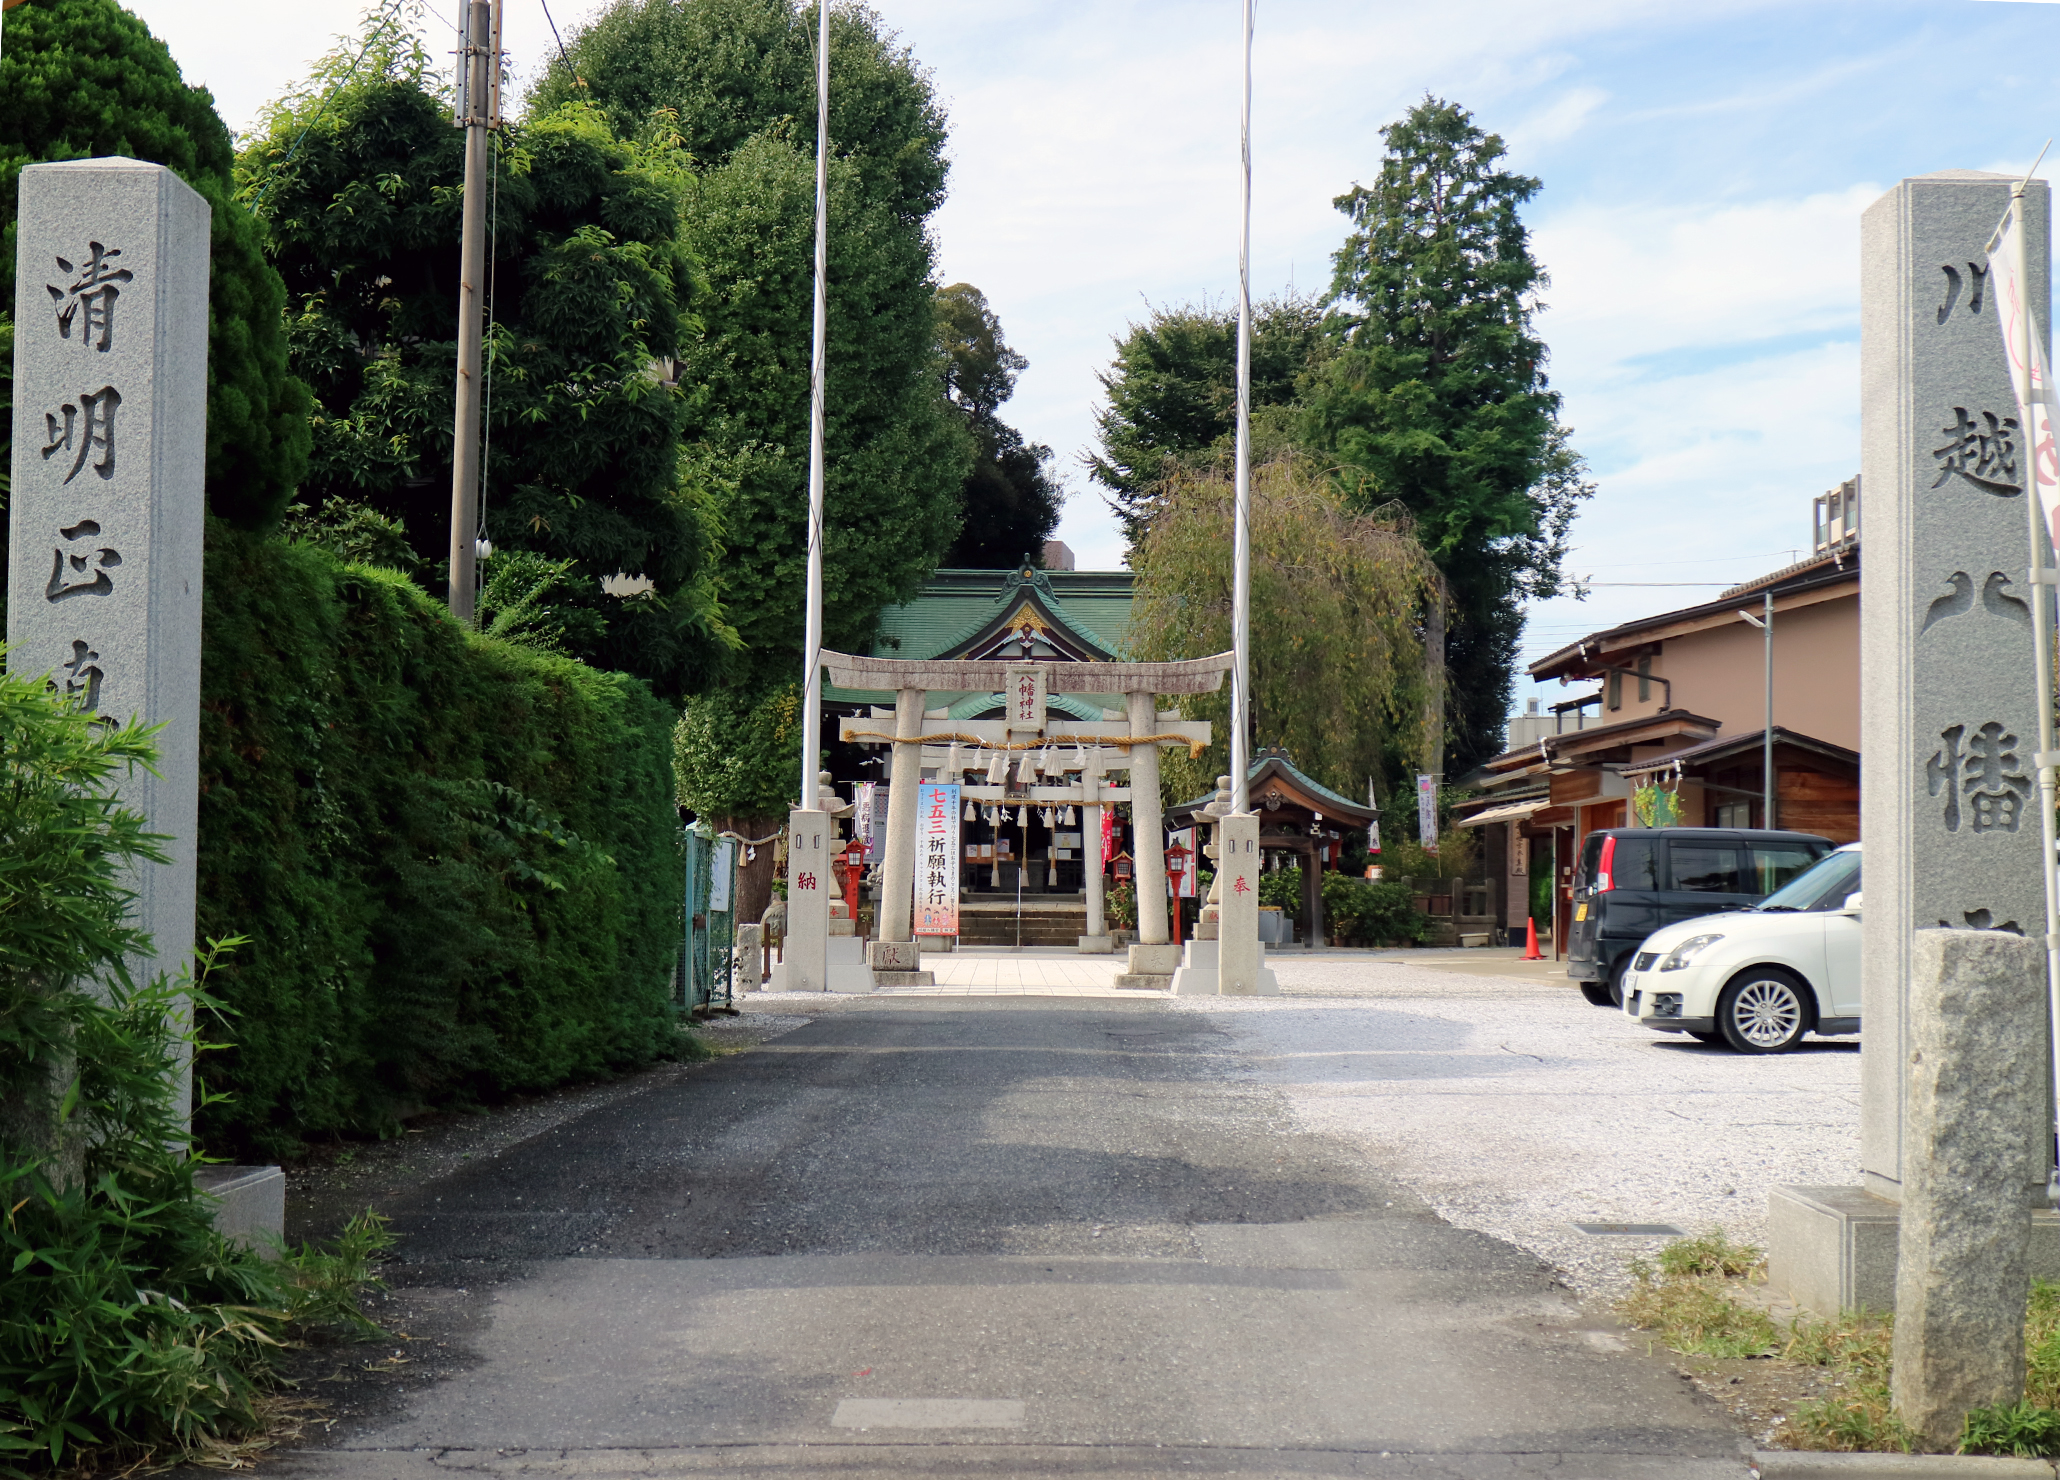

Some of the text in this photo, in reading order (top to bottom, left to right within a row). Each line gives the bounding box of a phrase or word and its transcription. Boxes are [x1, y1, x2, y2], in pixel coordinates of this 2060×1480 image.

[1018, 674, 1035, 720] 八幡神社
[926, 788, 947, 905] 七五三祈願執行
[797, 872, 816, 891] 納
[1233, 875, 1251, 897] 奉
